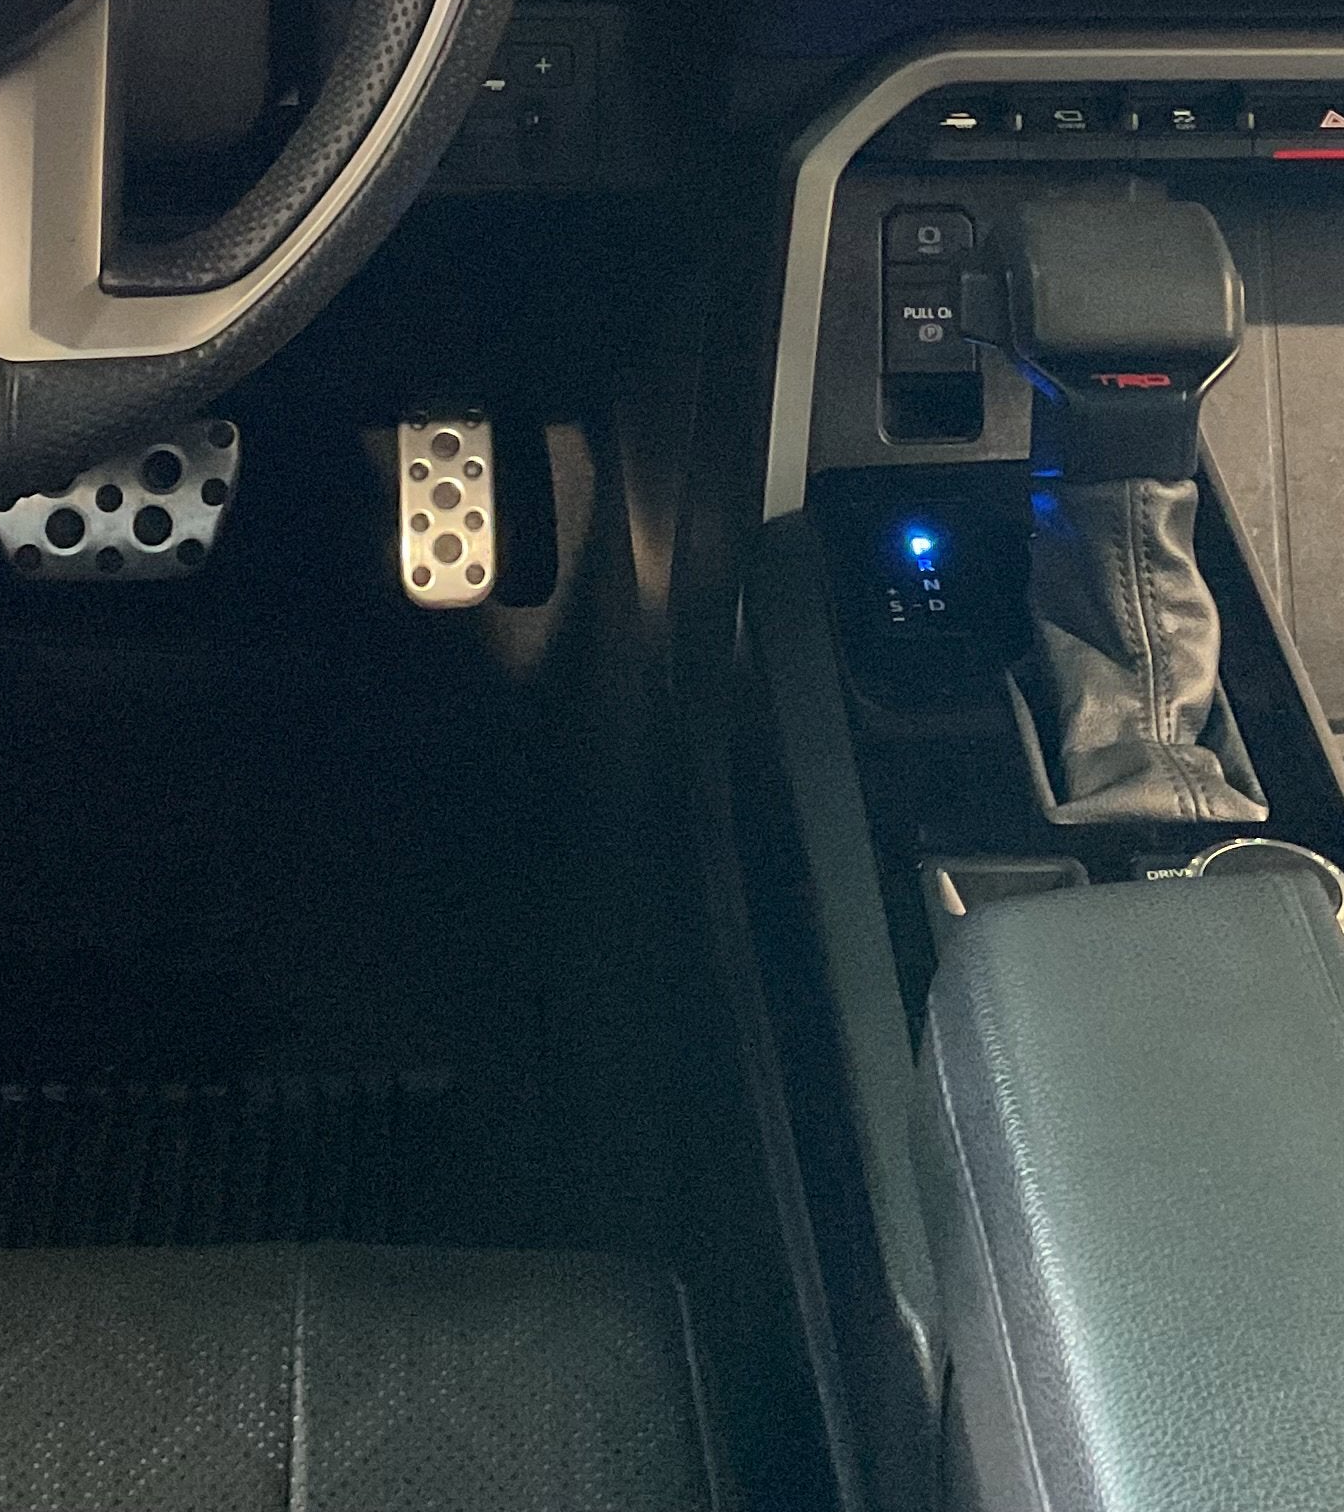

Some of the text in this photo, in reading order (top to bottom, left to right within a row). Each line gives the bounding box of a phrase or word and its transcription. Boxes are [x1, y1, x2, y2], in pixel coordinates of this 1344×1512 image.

[903, 306, 935, 319] PULL
[917, 558, 936, 572] R
[923, 578, 941, 591] N
[889, 598, 946, 612] S D
